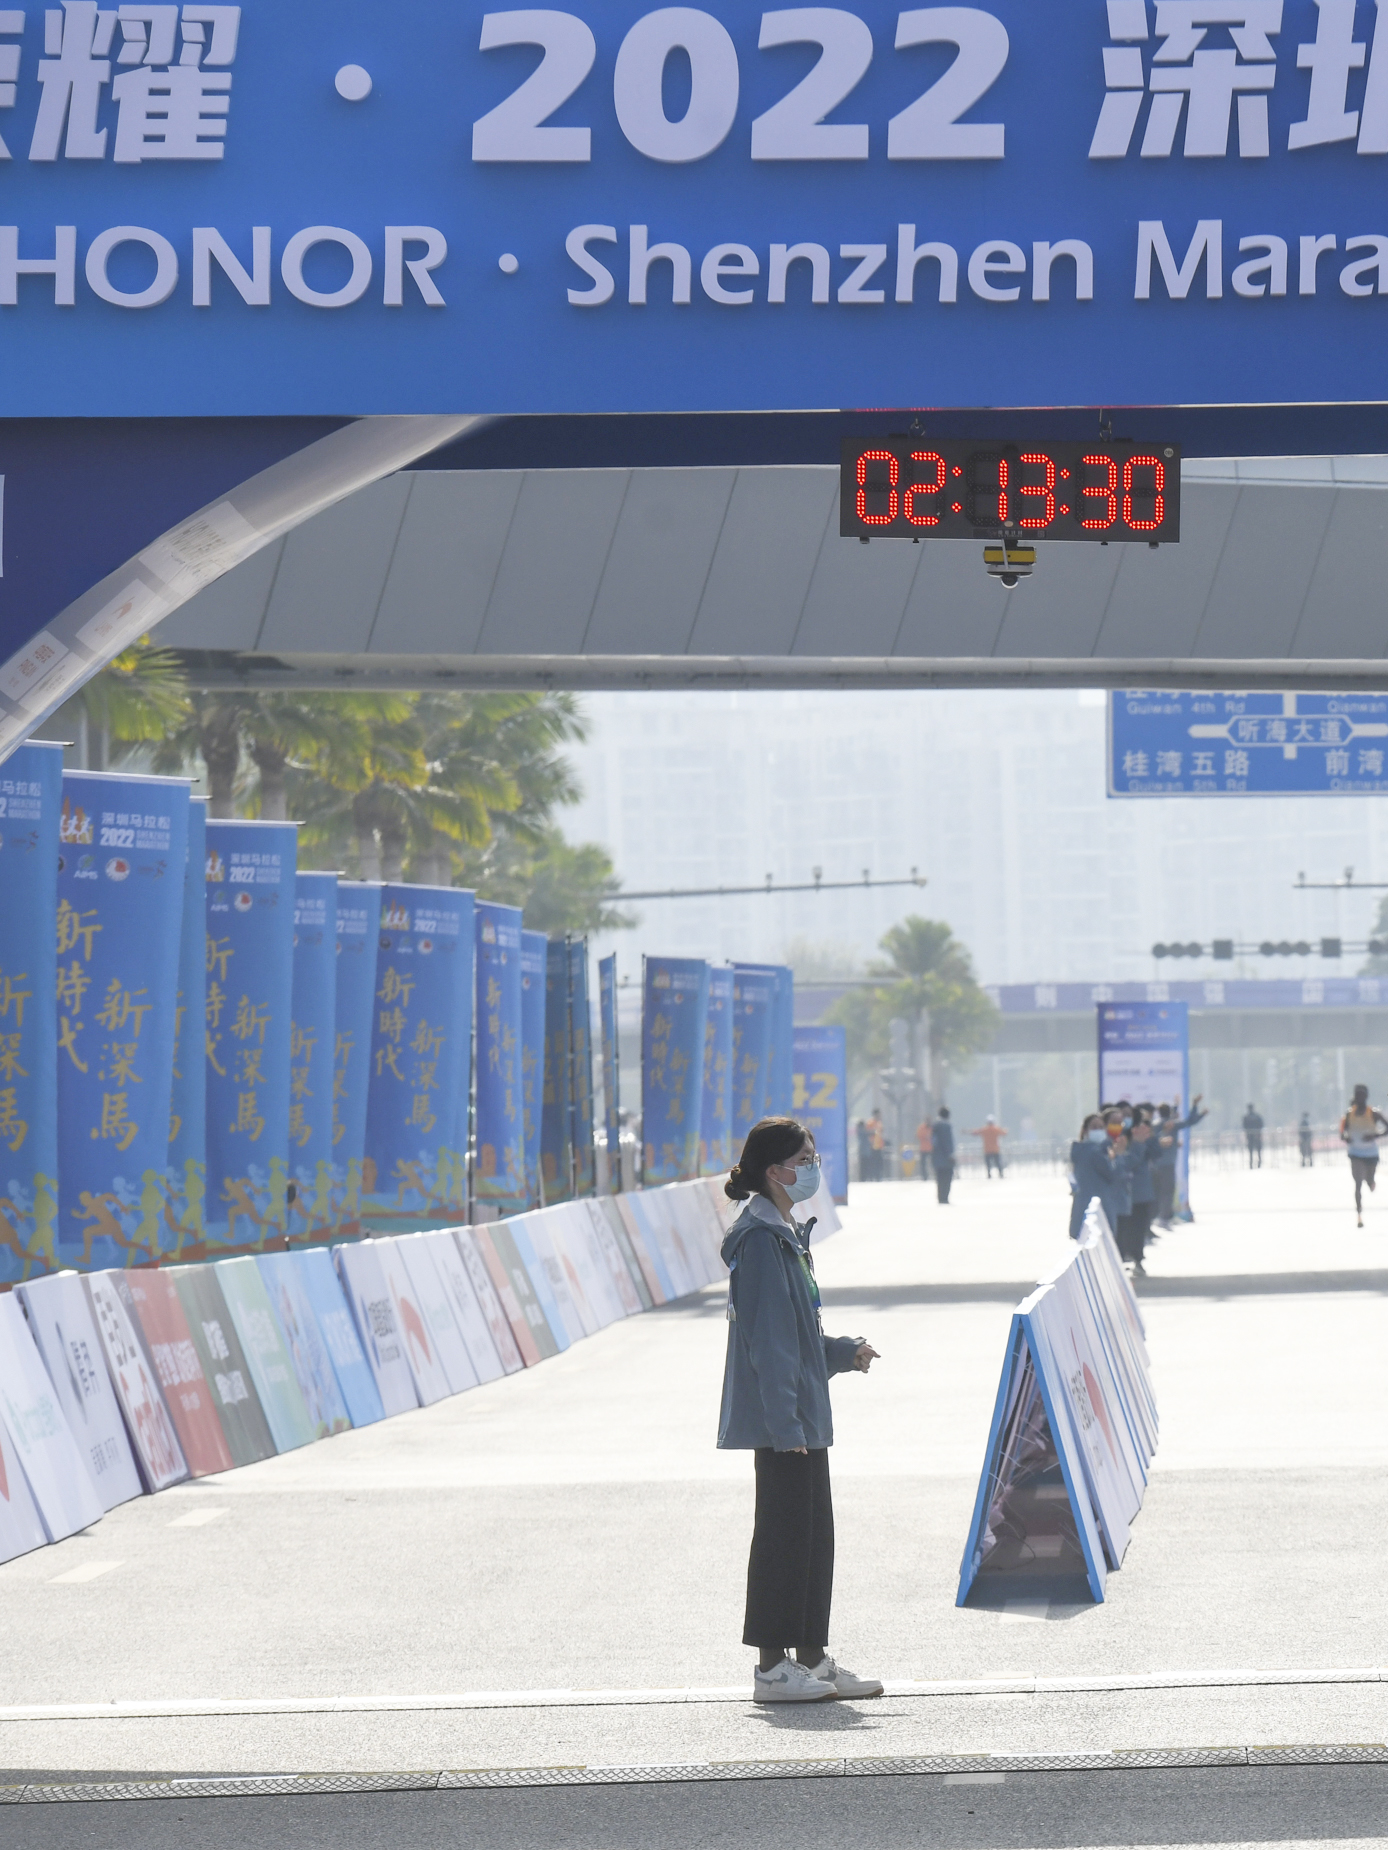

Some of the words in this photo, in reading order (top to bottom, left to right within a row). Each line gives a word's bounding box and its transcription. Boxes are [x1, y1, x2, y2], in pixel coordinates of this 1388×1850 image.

[0, 0, 241, 163] 耀
[472, 6, 1009, 162] 2022
[0, 225, 447, 309] HONOR
[565, 223, 1093, 306] Shenzhen
[856, 450, 1165, 531] 02:13:30
[1237, 719, 1343, 743] 听海大道
[0, 780, 42, 797] 马拉松
[1122, 750, 1251, 778] 桂湾五路
[100, 826, 135, 848] 2022
[101, 811, 171, 830] 深圳马拉松
[90, 978, 153, 1152] 新深馬
[229, 993, 273, 1142] 新深馬
